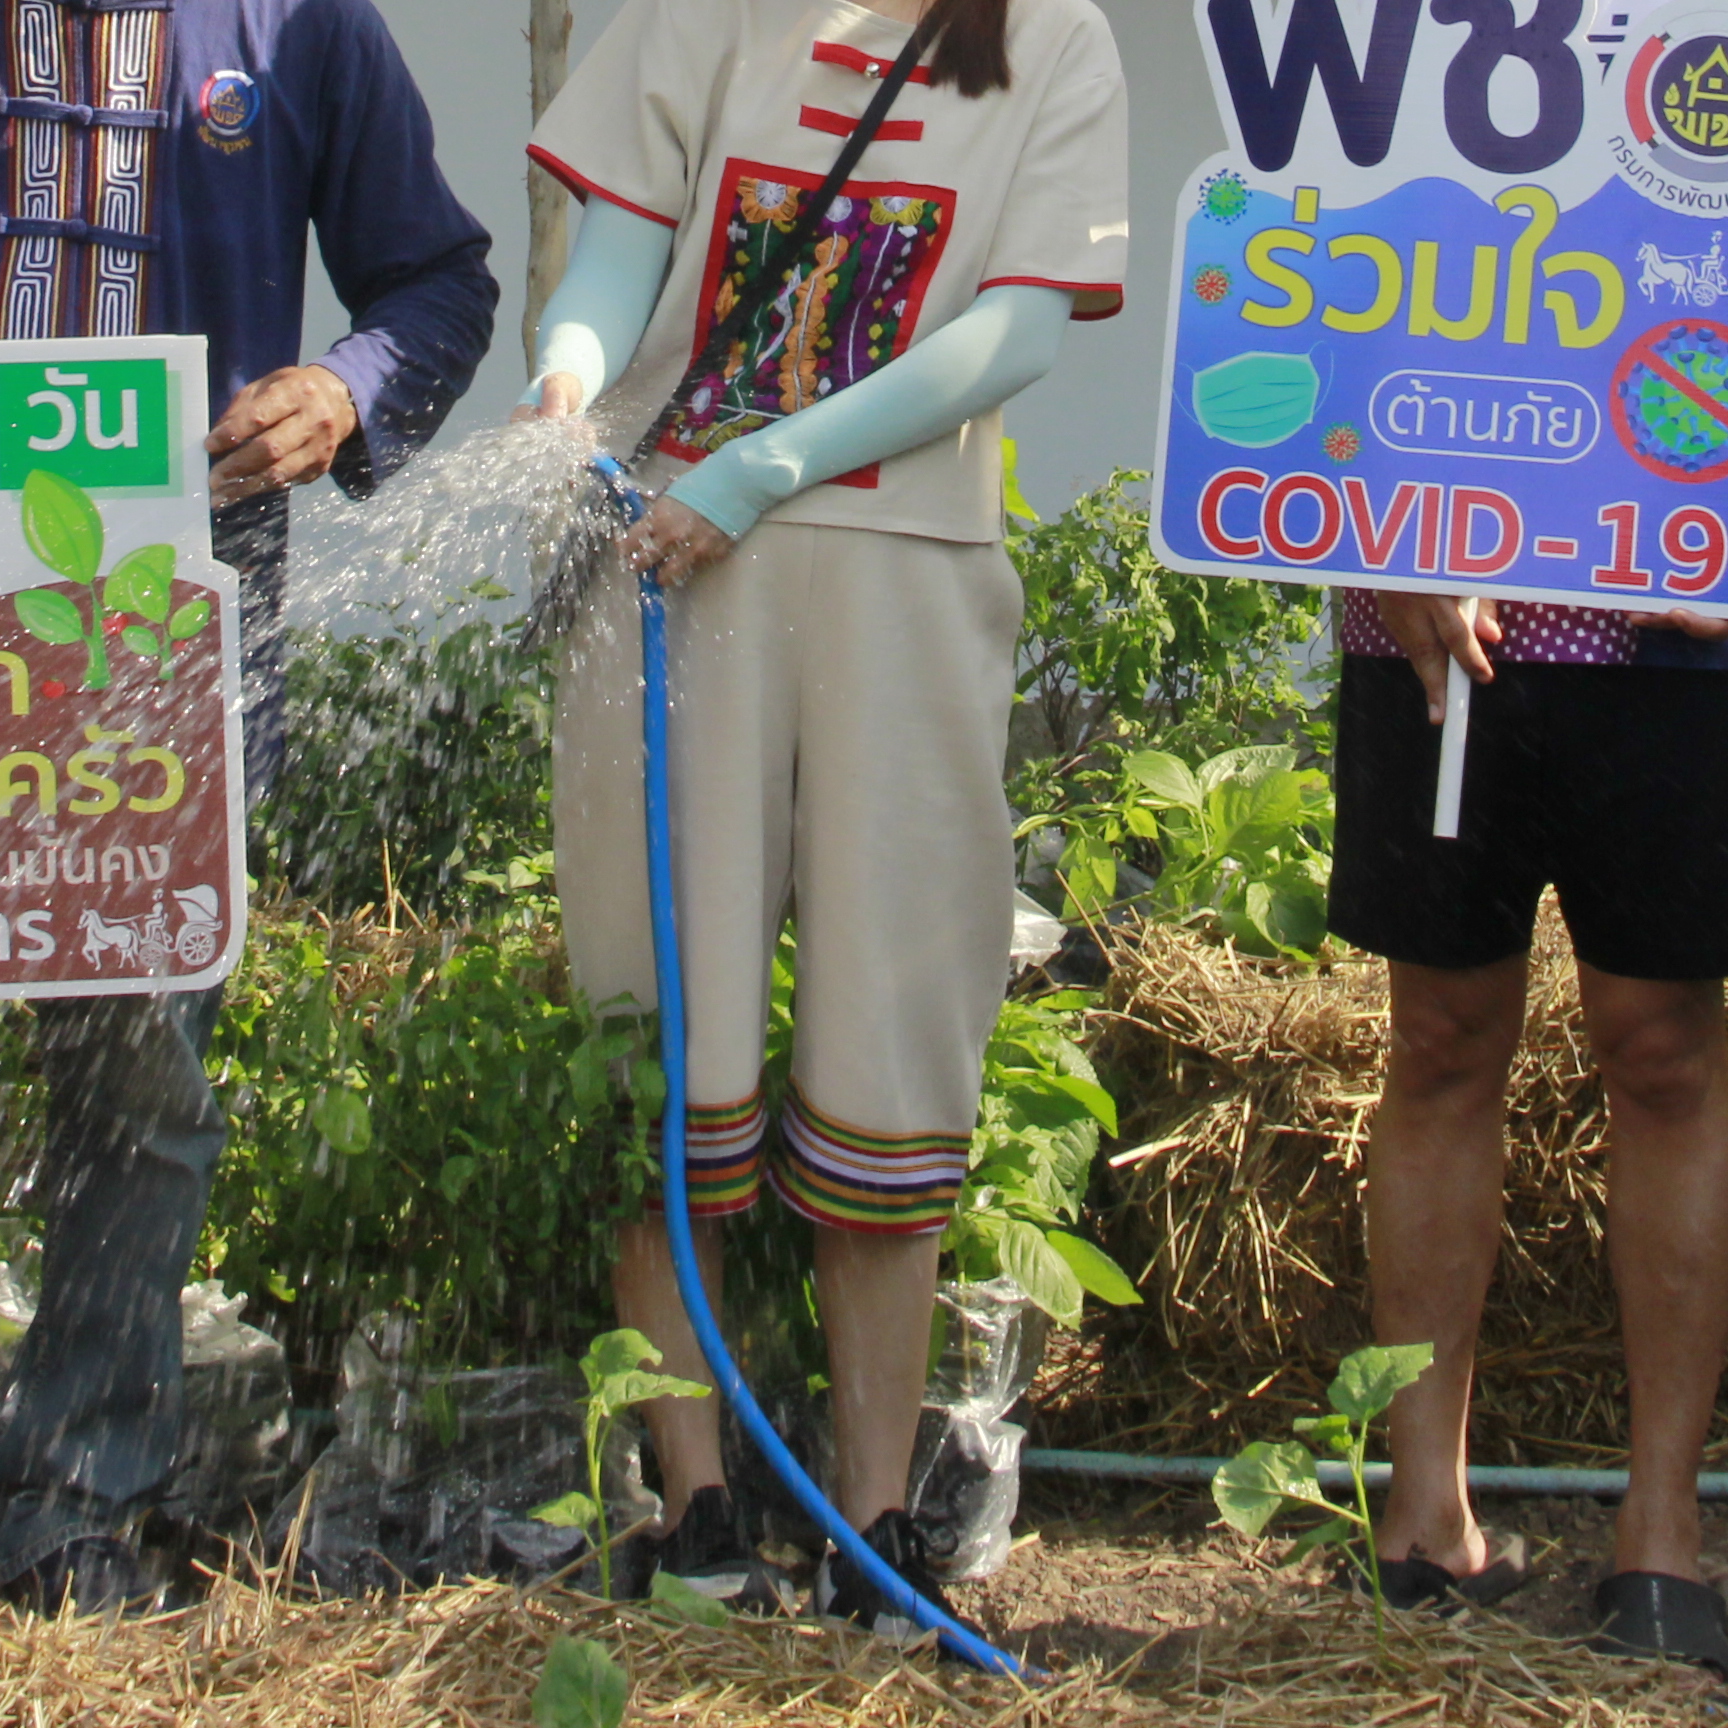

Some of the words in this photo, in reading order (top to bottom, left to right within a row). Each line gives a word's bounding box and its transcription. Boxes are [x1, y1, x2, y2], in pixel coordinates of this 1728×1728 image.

[1239, 185, 1625, 349] ร่วมใจ
[27, 367, 140, 452] วัน
[1386, 380, 1584, 450] ต้านภัย
